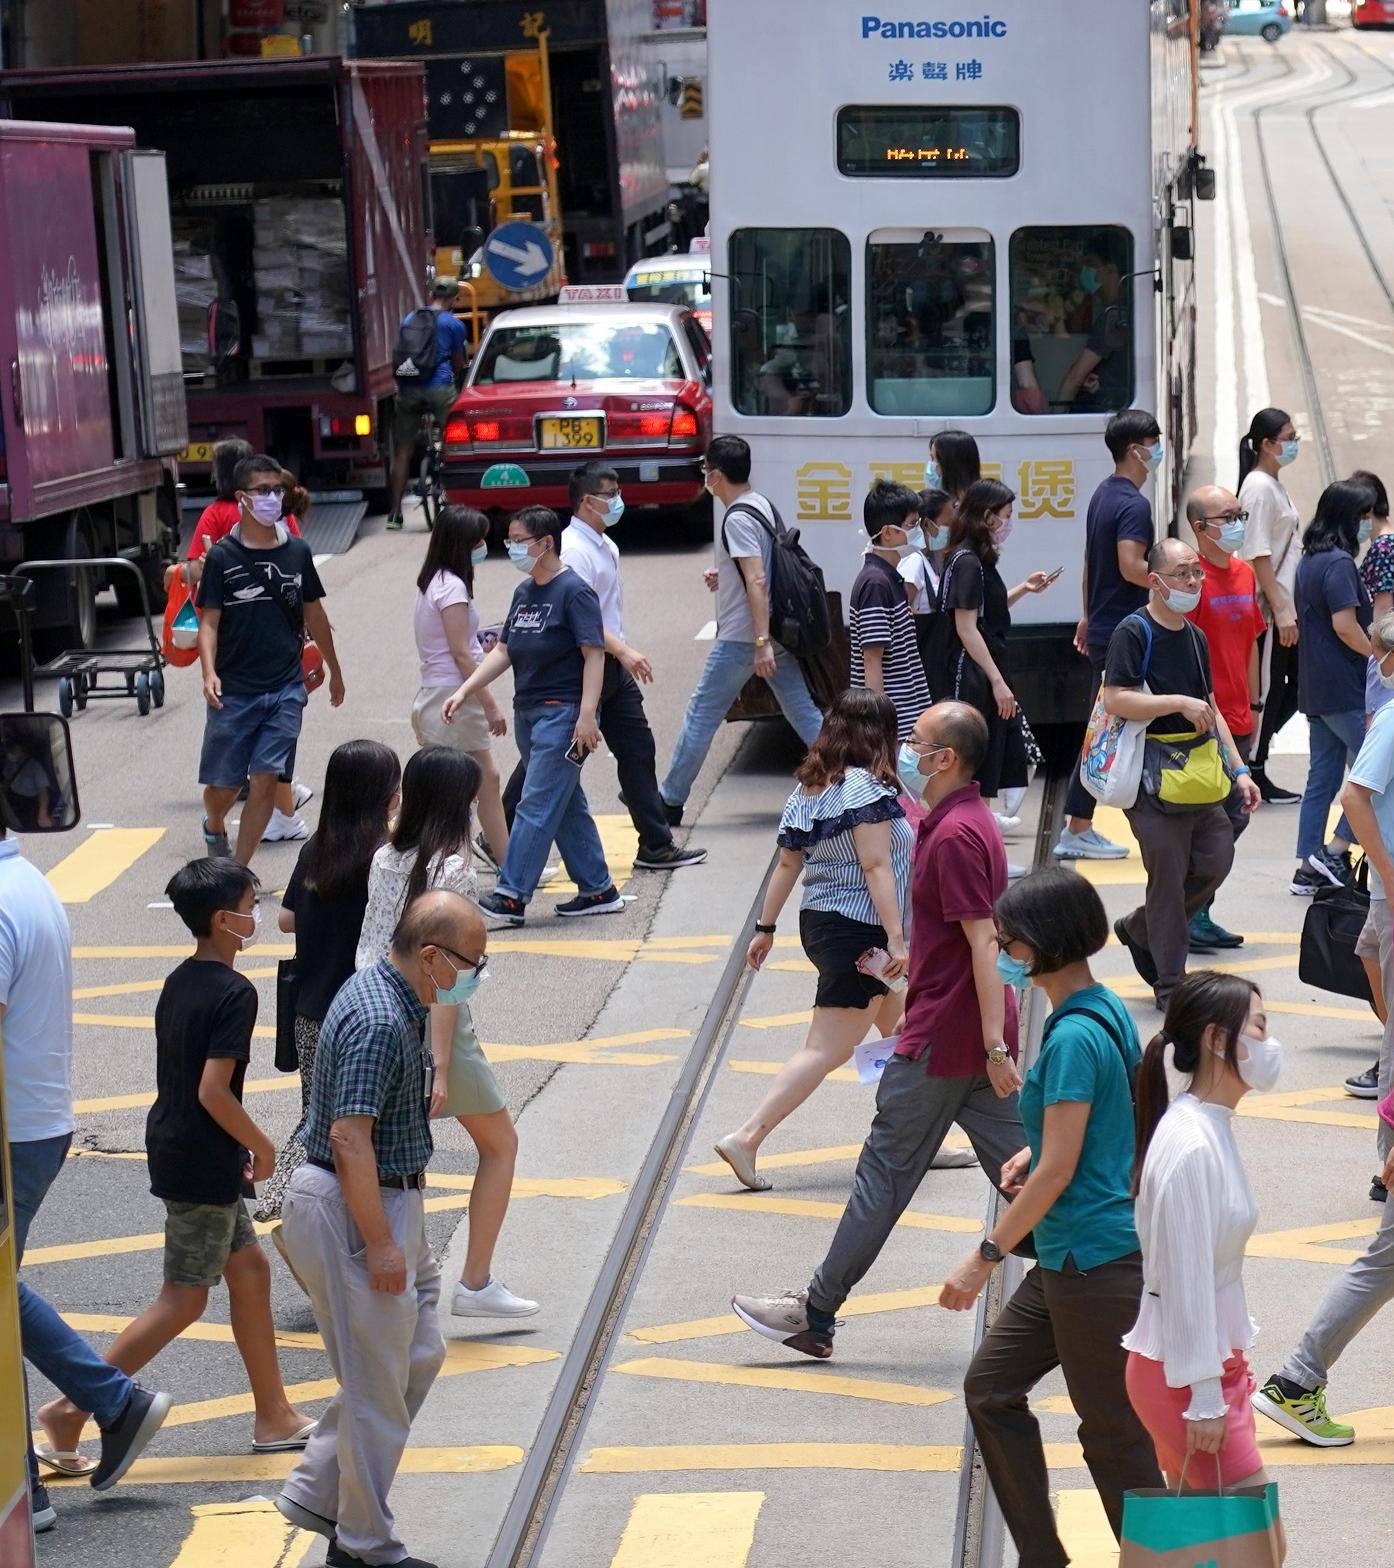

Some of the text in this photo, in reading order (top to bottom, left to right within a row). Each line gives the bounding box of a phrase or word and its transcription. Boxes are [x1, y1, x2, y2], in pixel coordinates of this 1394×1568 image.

[862, 15, 1007, 39] Panasonic
[565, 287, 622, 300] TAXI
[559, 418, 582, 433] PB
[553, 433, 593, 448] 1399
